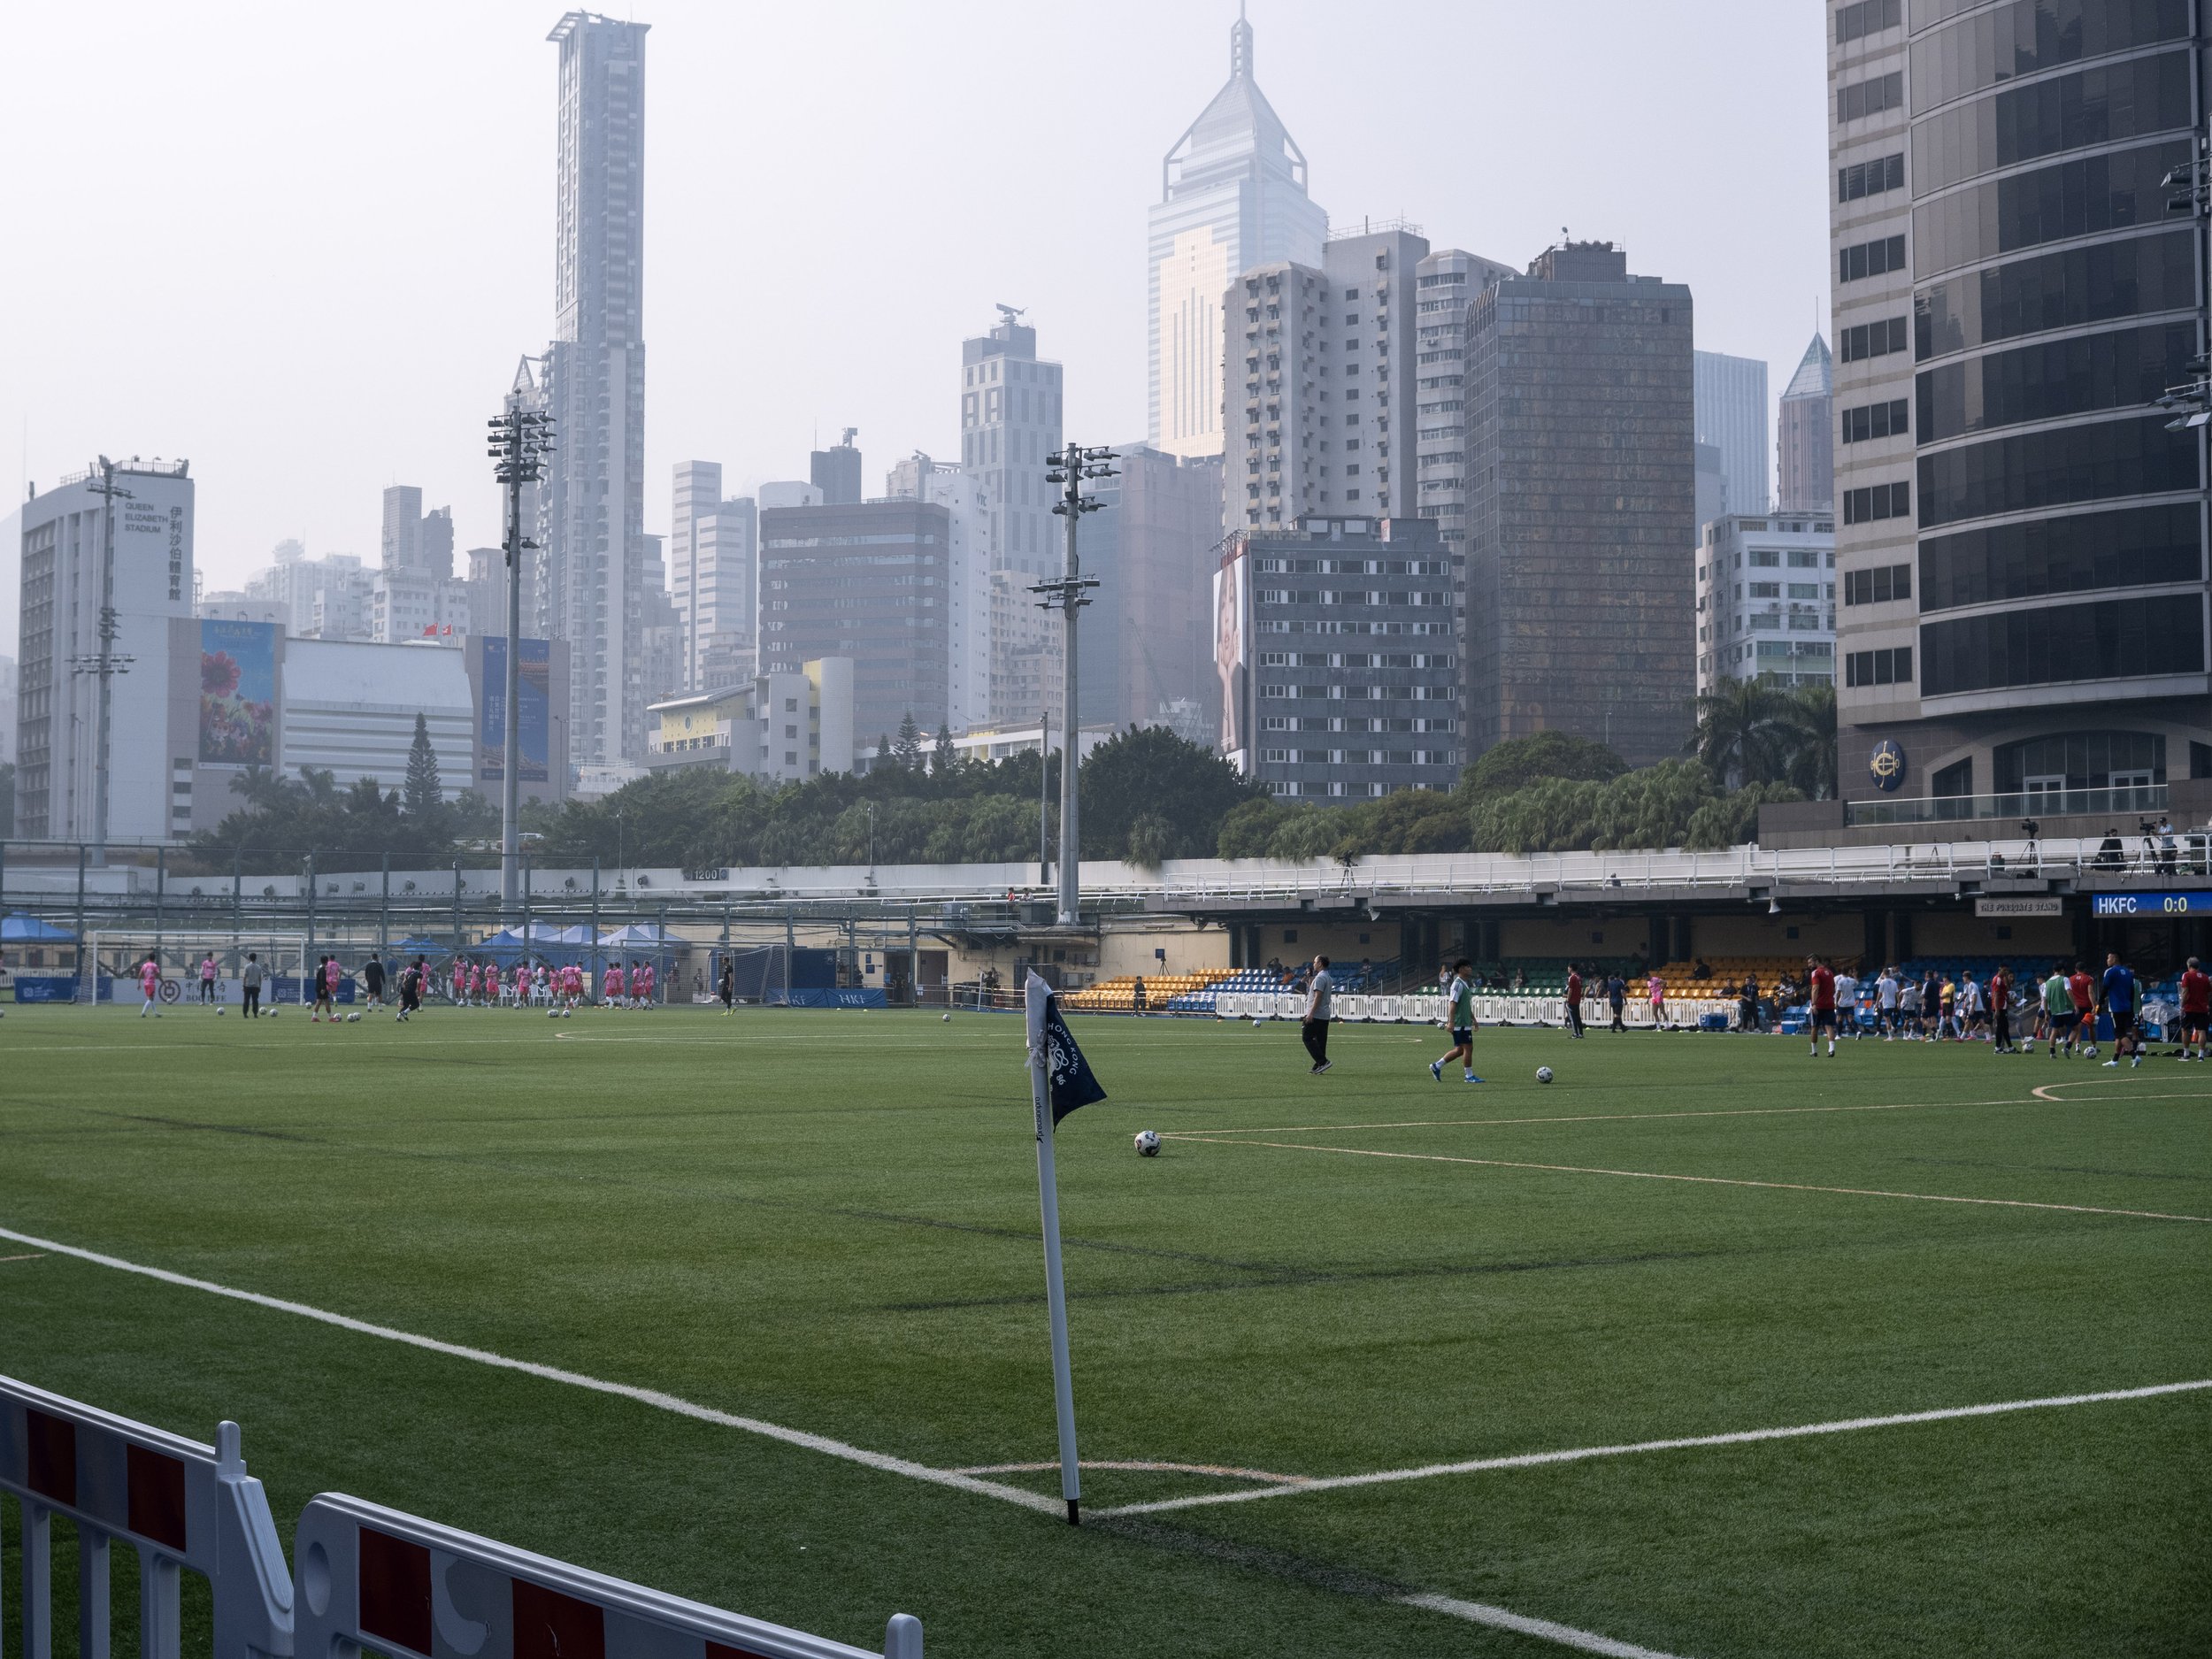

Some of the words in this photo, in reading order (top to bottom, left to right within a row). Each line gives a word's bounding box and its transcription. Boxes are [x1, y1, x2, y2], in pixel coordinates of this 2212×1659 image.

[125, 502, 155, 511] QUEEN
[125, 513, 169, 523] ELIZABETH
[125, 524, 161, 534] STADIUM
[167, 506, 182, 601] 伊利沙伯體育館
[694, 870, 718, 880] 1200
[1981, 902, 1994, 912] THE
[2034, 902, 2059, 912] STAND
[2098, 896, 2138, 914] HKFC
[2163, 896, 2188, 913] 0:0
[1048, 1022, 1072, 1045] HONG
[1069, 1047, 1079, 1075] KONG
[1035, 1096, 1044, 1137] precisionpro
